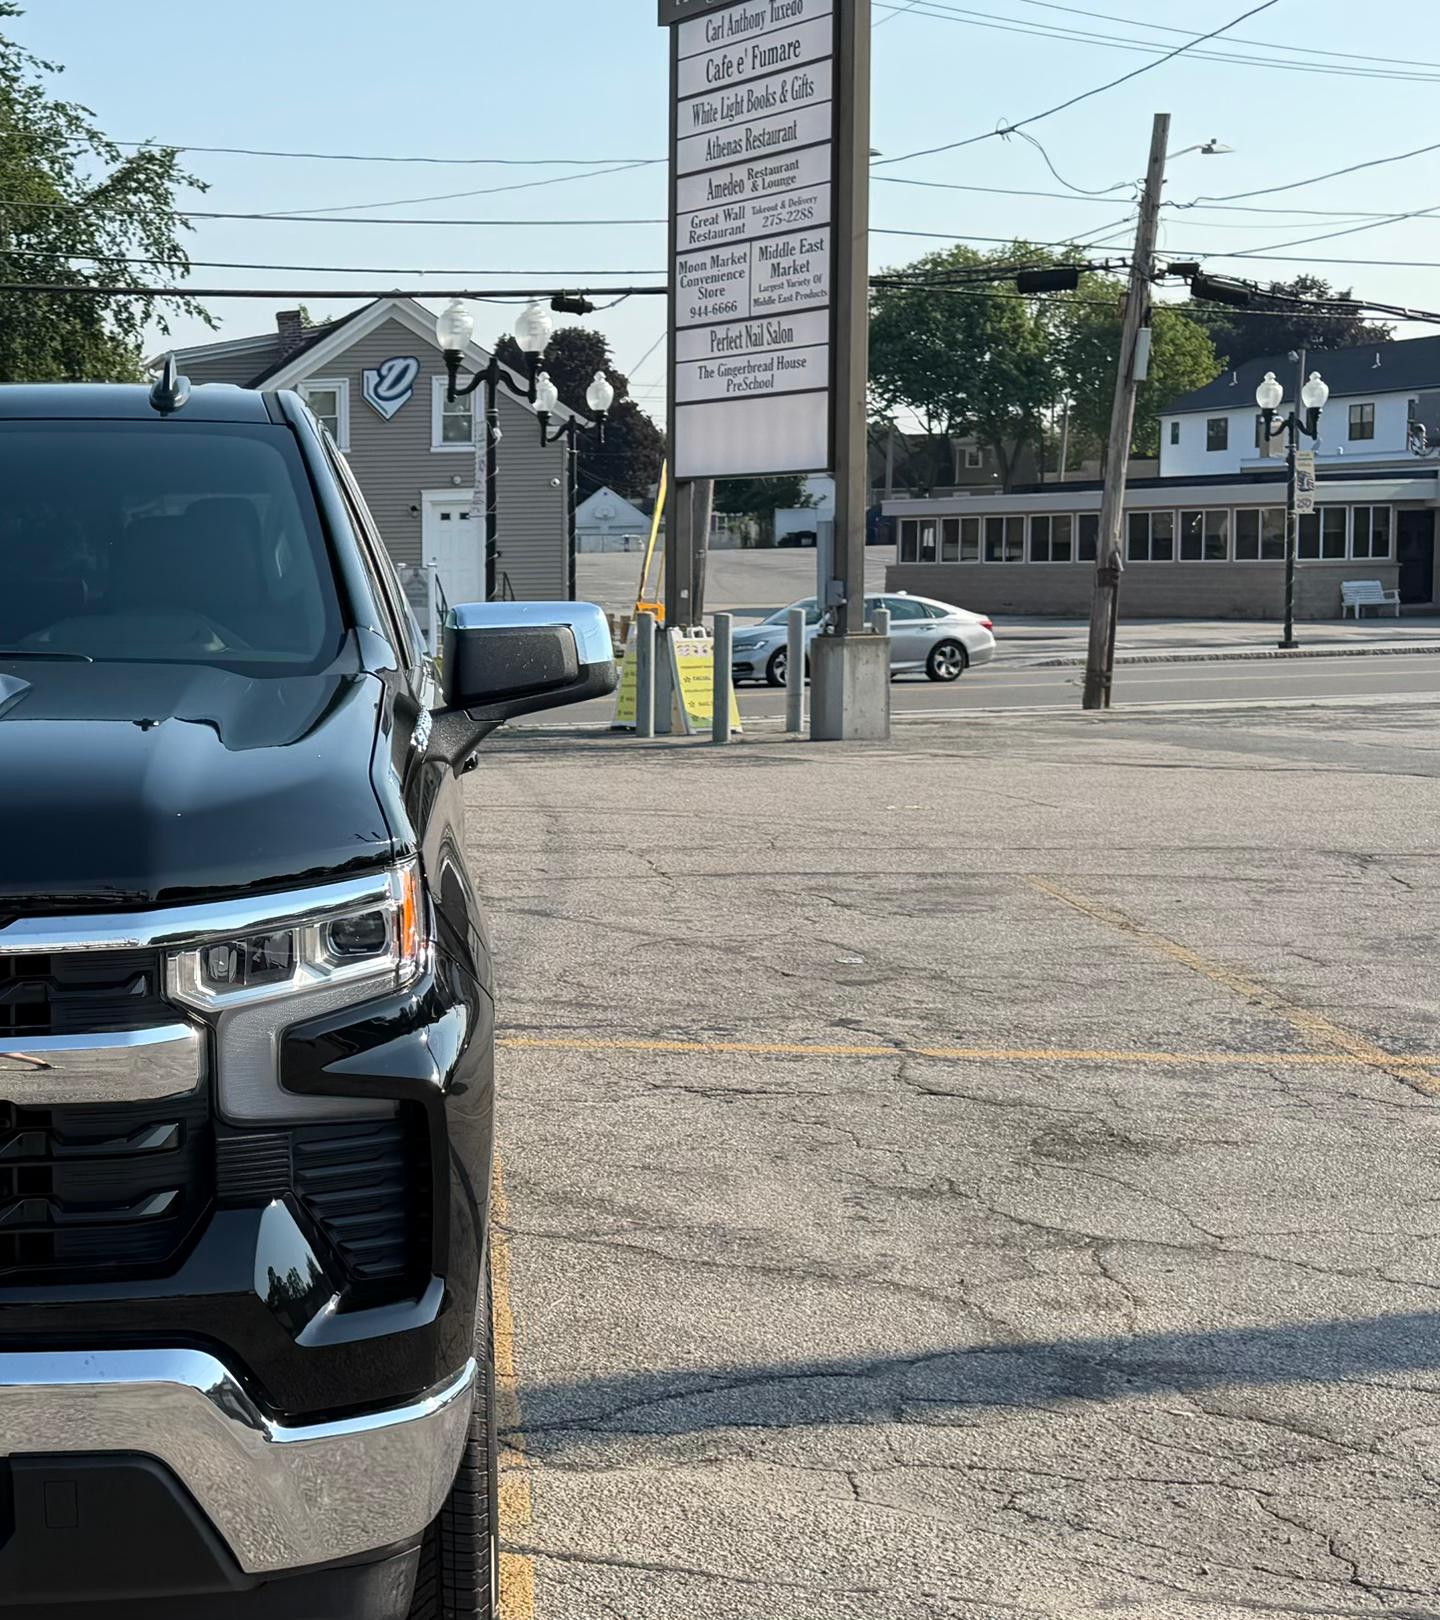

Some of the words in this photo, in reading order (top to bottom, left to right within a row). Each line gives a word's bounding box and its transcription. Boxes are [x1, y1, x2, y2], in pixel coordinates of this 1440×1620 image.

[706, 16, 725, 43] Carl
[727, 8, 766, 37] Anthony
[769, 0, 803, 22] Tuxedo
[706, 54, 733, 83] Cafe
[752, 39, 801, 71] Fumare
[692, 102, 718, 127] White
[720, 93, 744, 121] Light
[746, 84, 777, 114] Books
[779, 79, 788, 103] &
[791, 74, 815, 101] Gifts
[705, 135, 743, 162] Athenas
[745, 120, 798, 152] Restaurant
[747, 159, 800, 181] Restaurant
[707, 173, 745, 201] Amedeo
[750, 180, 760, 193] &
[762, 174, 797, 191] Lounge
[751, 202, 779, 215] Takeout
[788, 195, 818, 209] Delivery
[690, 211, 719, 229] Great
[723, 206, 746, 222] Wall
[762, 207, 814, 229] 275-2288
[688, 223, 746, 244] Restaurant
[758, 242, 797, 262] Middle
[799, 237, 825, 254] East
[678, 260, 707, 275] Moon
[710, 252, 748, 269] Market
[770, 259, 810, 279] Market
[680, 269, 746, 289] Convenience
[758, 280, 785, 293] Largest
[786, 276, 810, 290] Variety
[812, 273, 823, 284] Of
[698, 286, 726, 300] Store
[753, 295, 776, 307] Middle
[778, 293, 794, 304] East
[795, 289, 828, 302] Products
[690, 300, 738, 319] 944-6666
[710, 326, 743, 353] Perfect
[745, 323, 764, 349] Nail
[766, 320, 794, 346] Salon
[698, 364, 715, 380] The
[717, 356, 774, 378] Gingerbread
[776, 355, 807, 371] House
[726, 374, 774, 393] PreSchool
